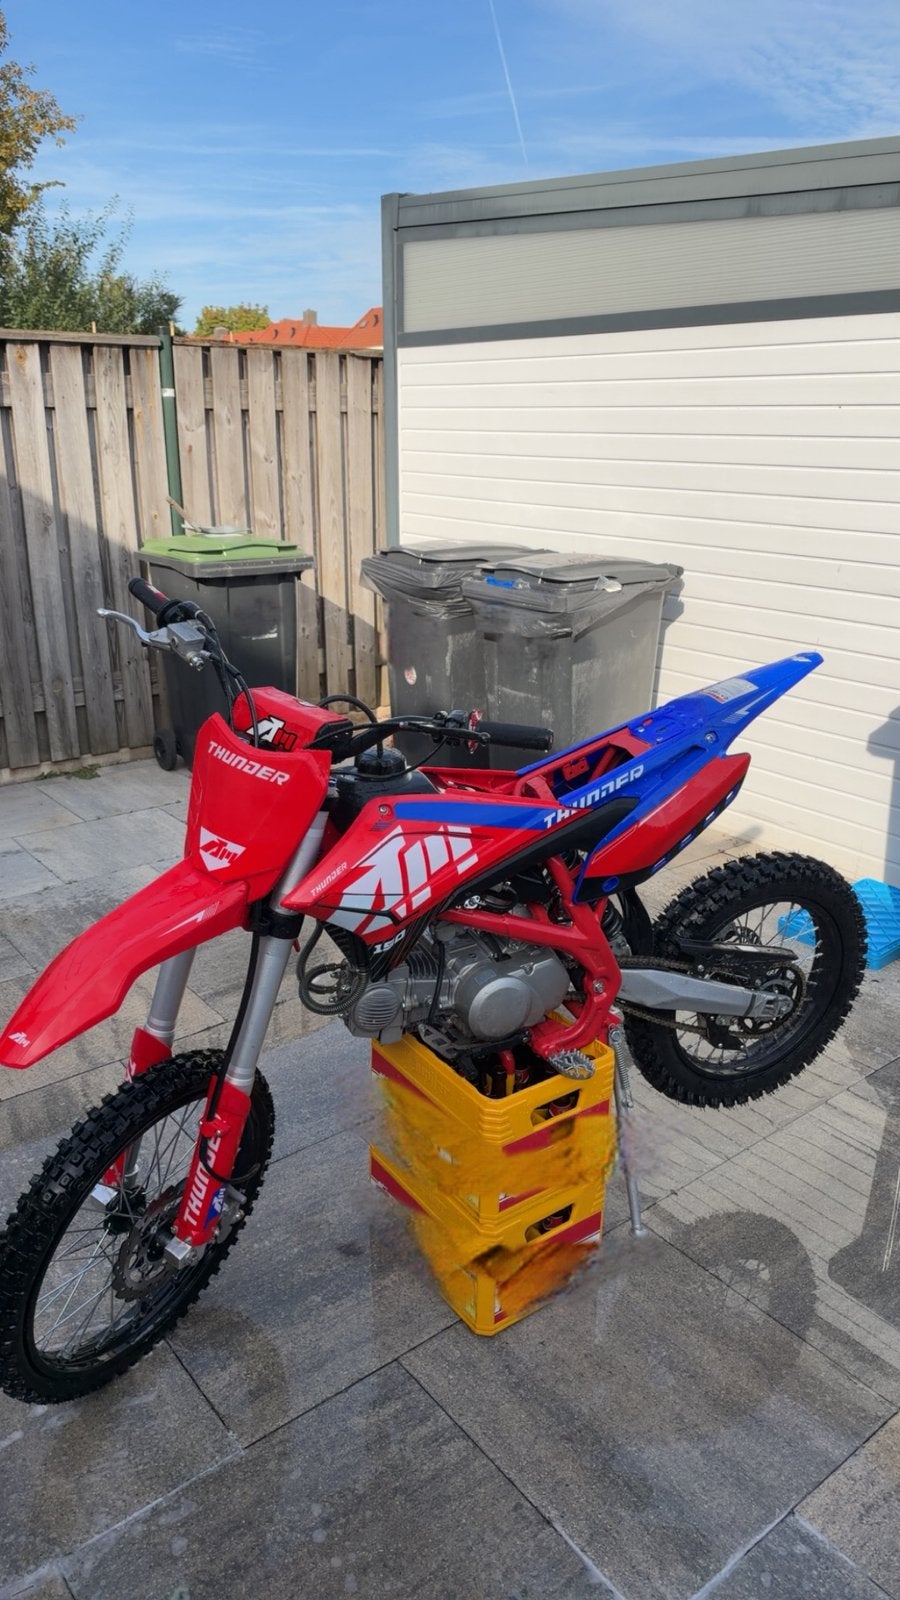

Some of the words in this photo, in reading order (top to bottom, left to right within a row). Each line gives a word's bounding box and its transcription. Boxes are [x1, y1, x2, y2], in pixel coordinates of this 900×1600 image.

[208, 741, 290, 786] THUNDER
[311, 861, 347, 897] THUNDER
[373, 929, 407, 954] 150
